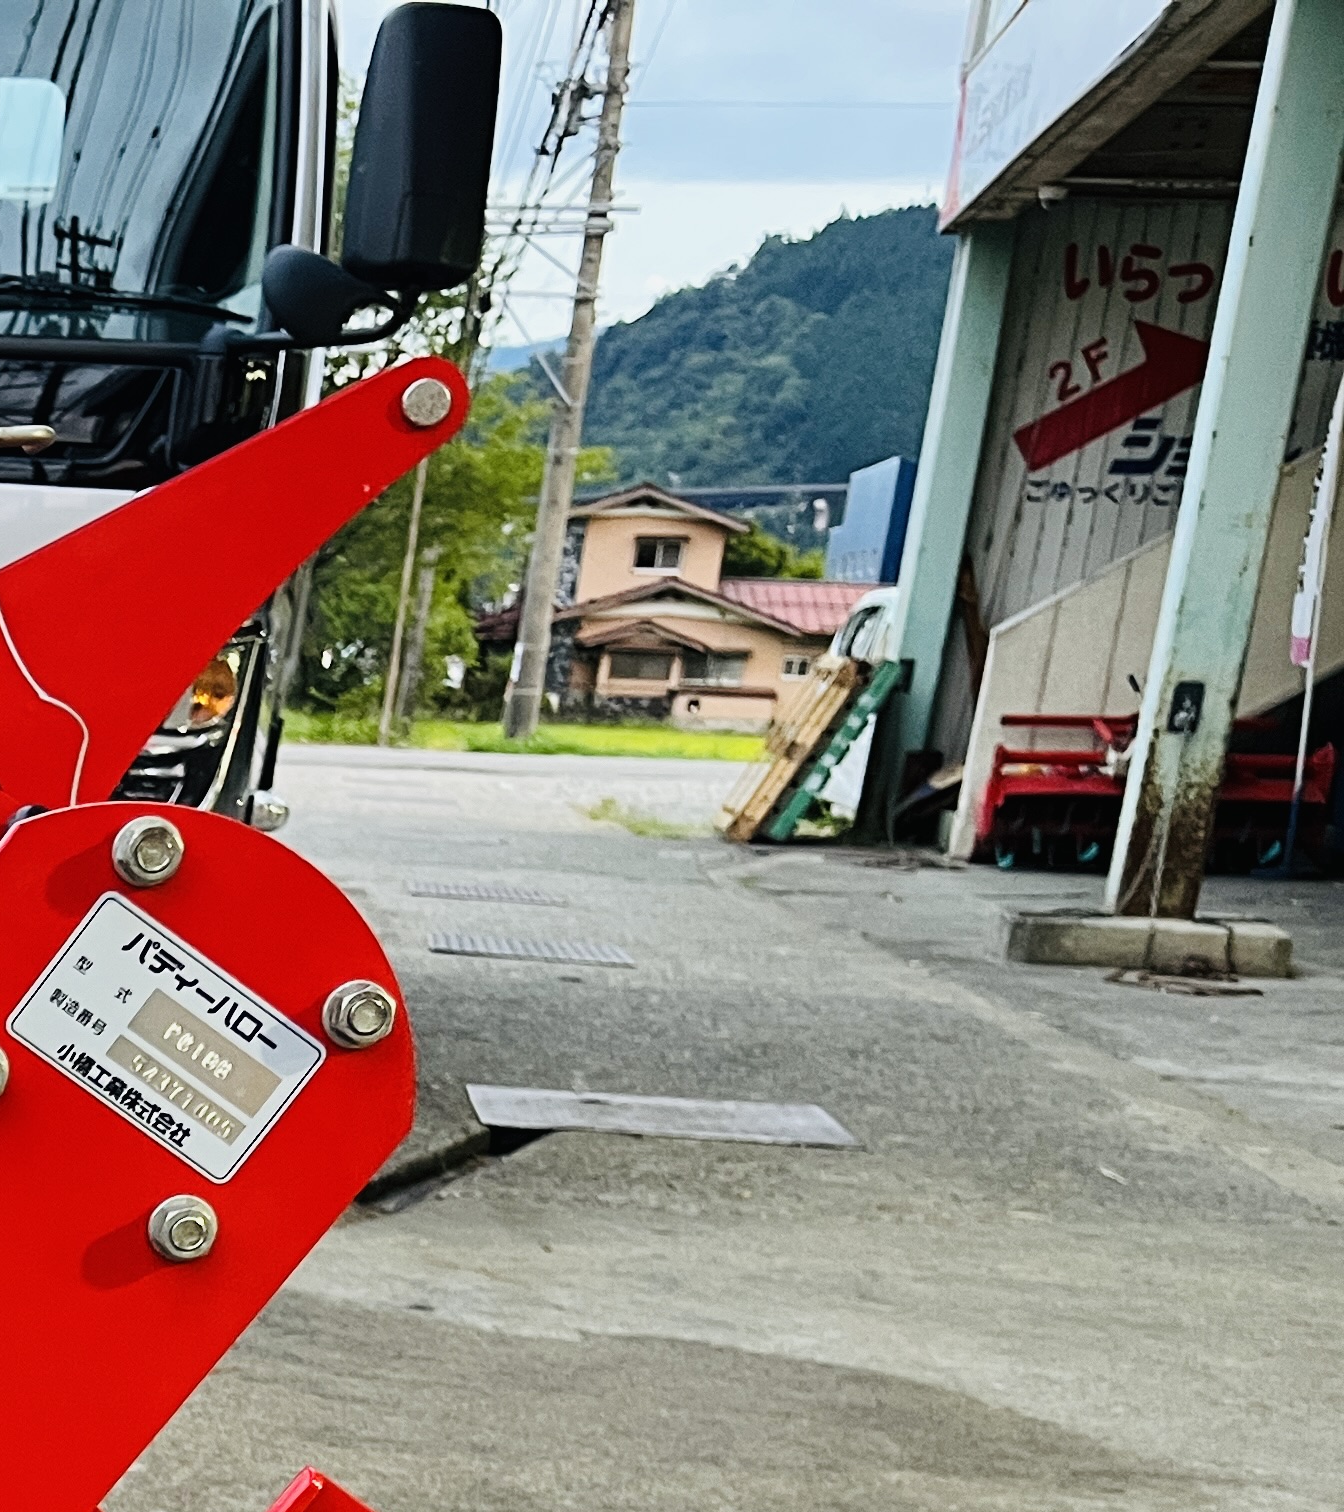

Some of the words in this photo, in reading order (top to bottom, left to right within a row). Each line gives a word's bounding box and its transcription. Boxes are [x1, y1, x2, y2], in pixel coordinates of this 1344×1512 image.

[1049, 336, 1108, 401] 2F
[49, 987, 107, 1036] 製造番号
[121, 932, 278, 1051] パディーハロー
[57, 1043, 191, 1147] 小橋工業株式会社
